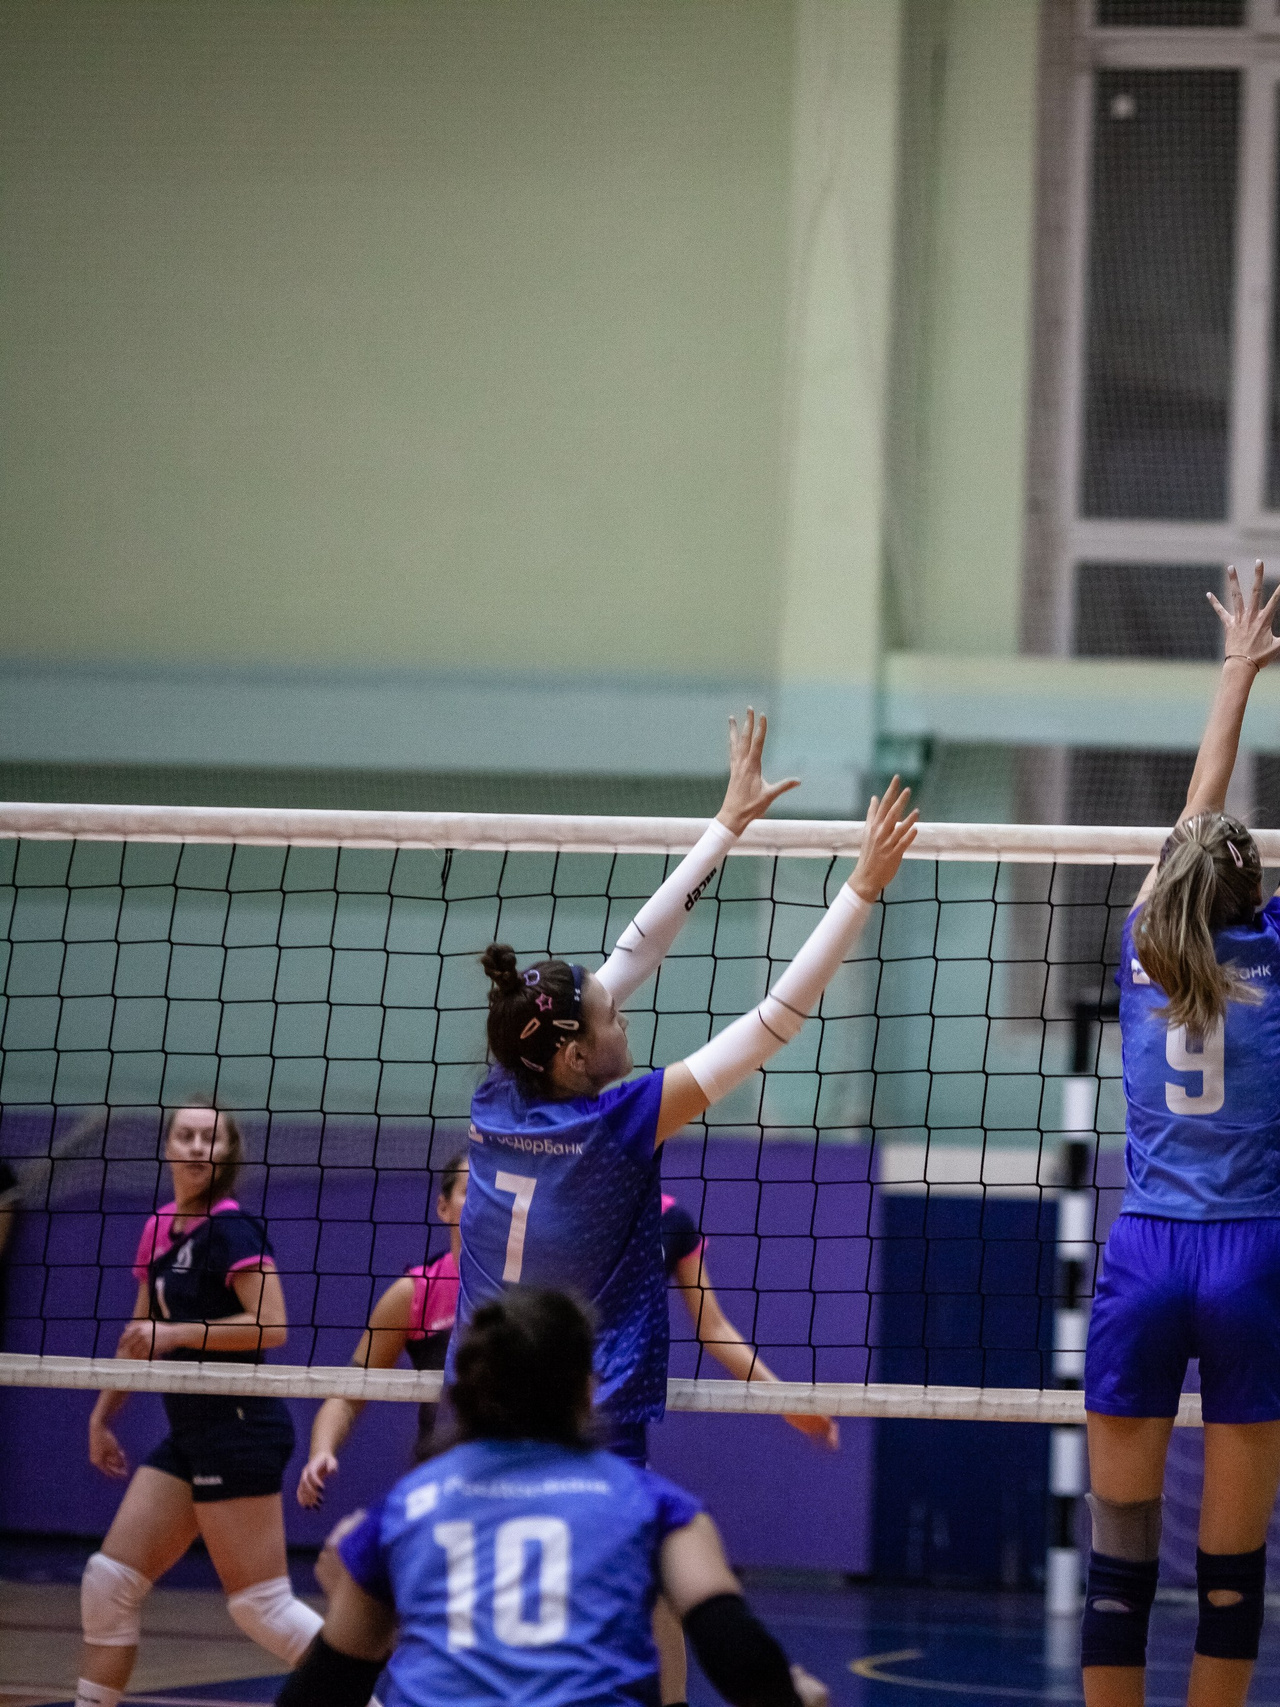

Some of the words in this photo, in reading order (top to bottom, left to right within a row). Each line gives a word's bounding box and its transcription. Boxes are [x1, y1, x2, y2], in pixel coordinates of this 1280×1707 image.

[1165, 1008, 1225, 1115] 9
[488, 1134, 583, 1155] осДорБанк
[494, 1169, 538, 1284] 7
[433, 1515, 571, 1652] 10
